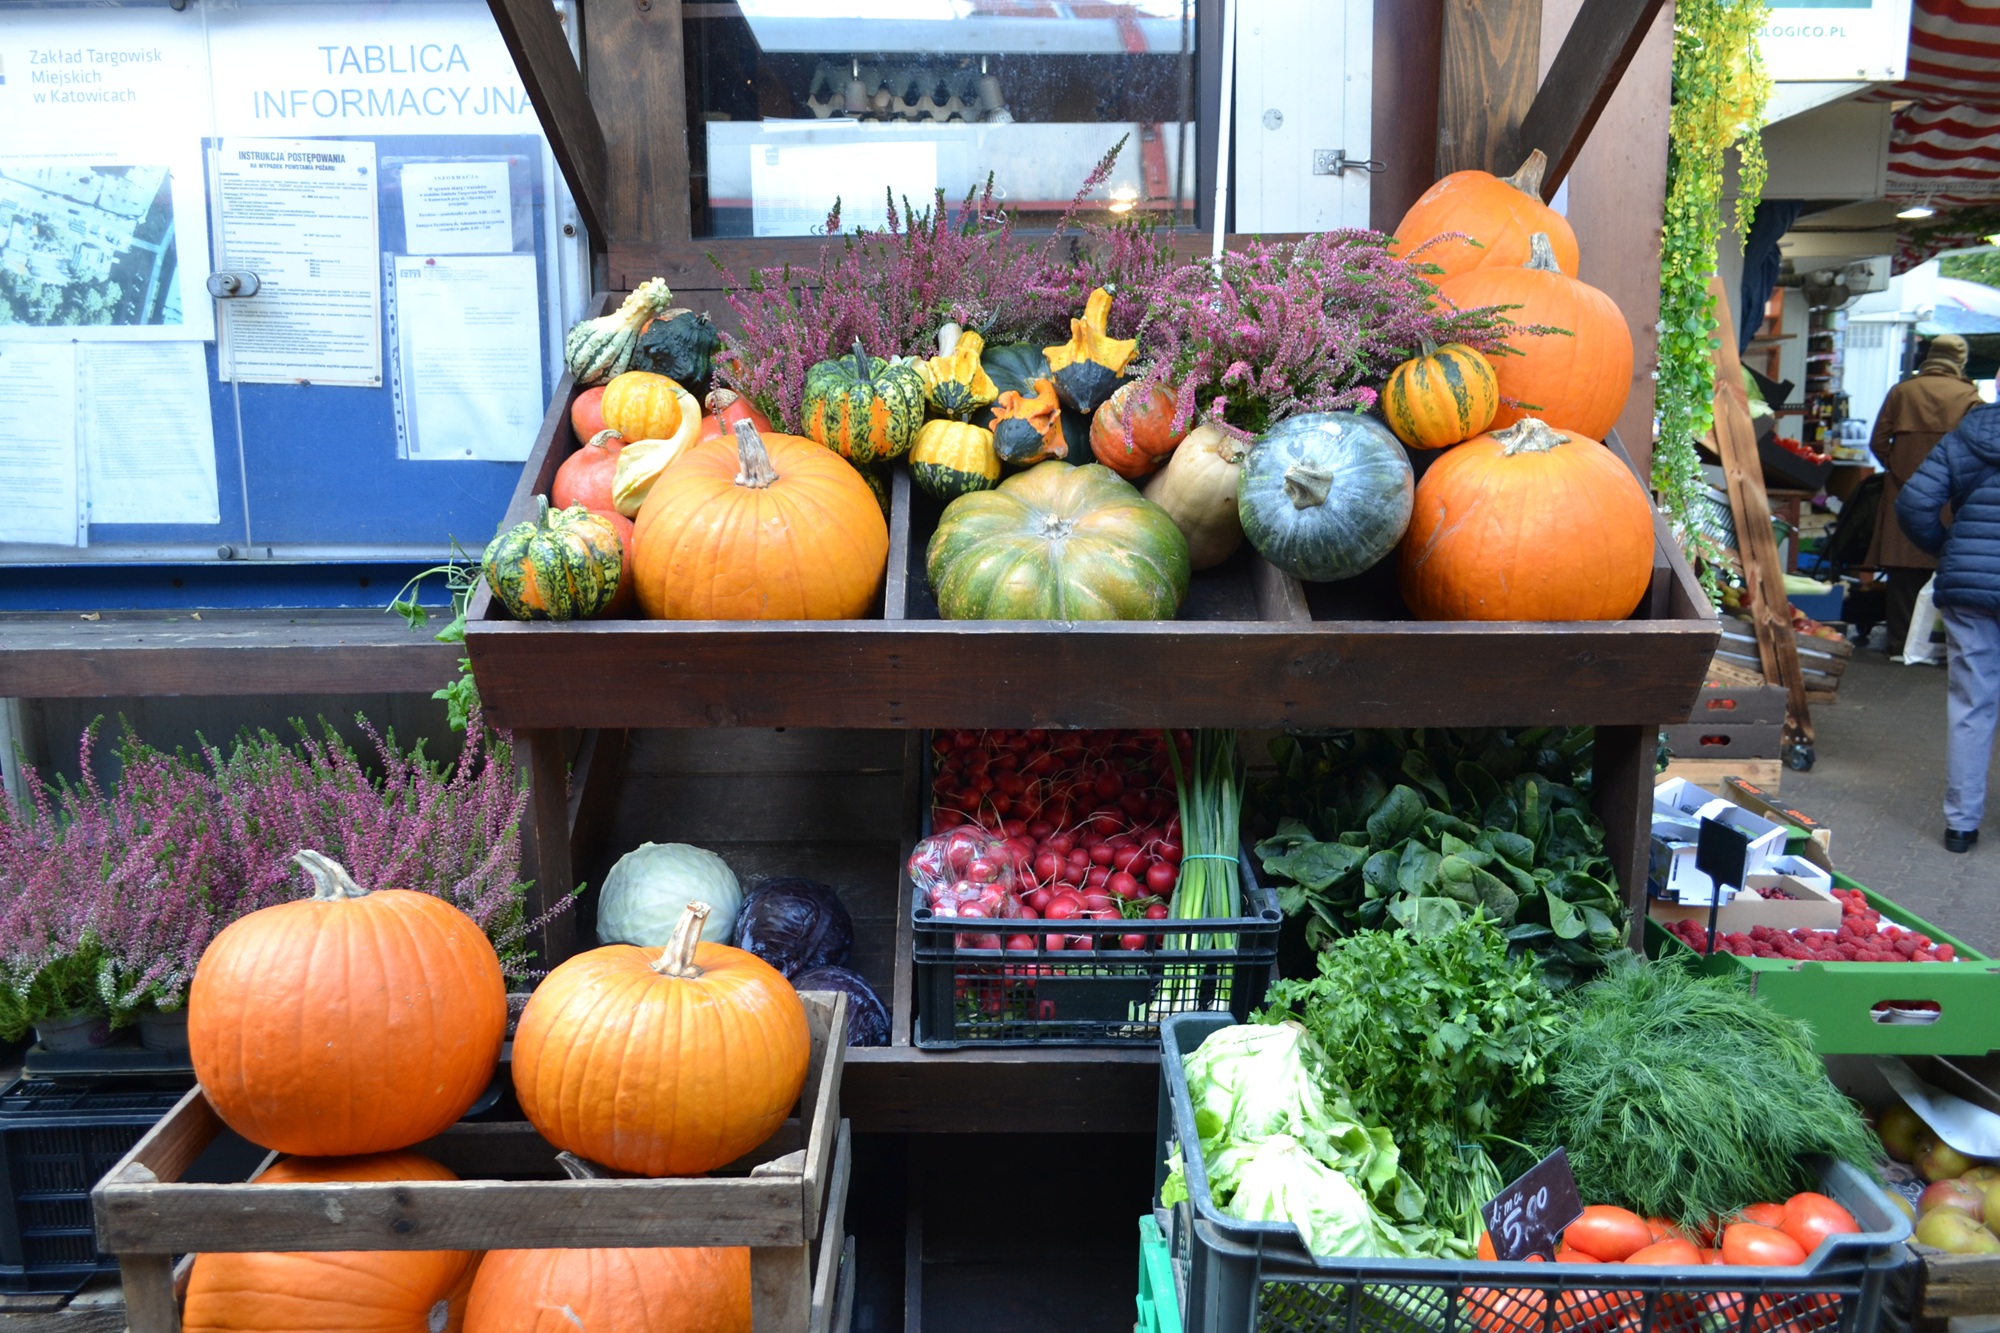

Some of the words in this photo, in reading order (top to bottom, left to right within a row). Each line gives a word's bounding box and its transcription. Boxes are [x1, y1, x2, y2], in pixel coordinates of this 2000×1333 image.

[29, 49, 82, 64] Zakład
[86, 48, 162, 66] Targowisk
[318, 44, 470, 75] TABLICA
[32, 70, 102, 86] Miejskich
[34, 92, 46, 103] w
[50, 88, 136, 103] Katowicach
[238, 151, 285, 162] INSTRUKCJA
[288, 152, 346, 165] POSTĘPOWANIA
